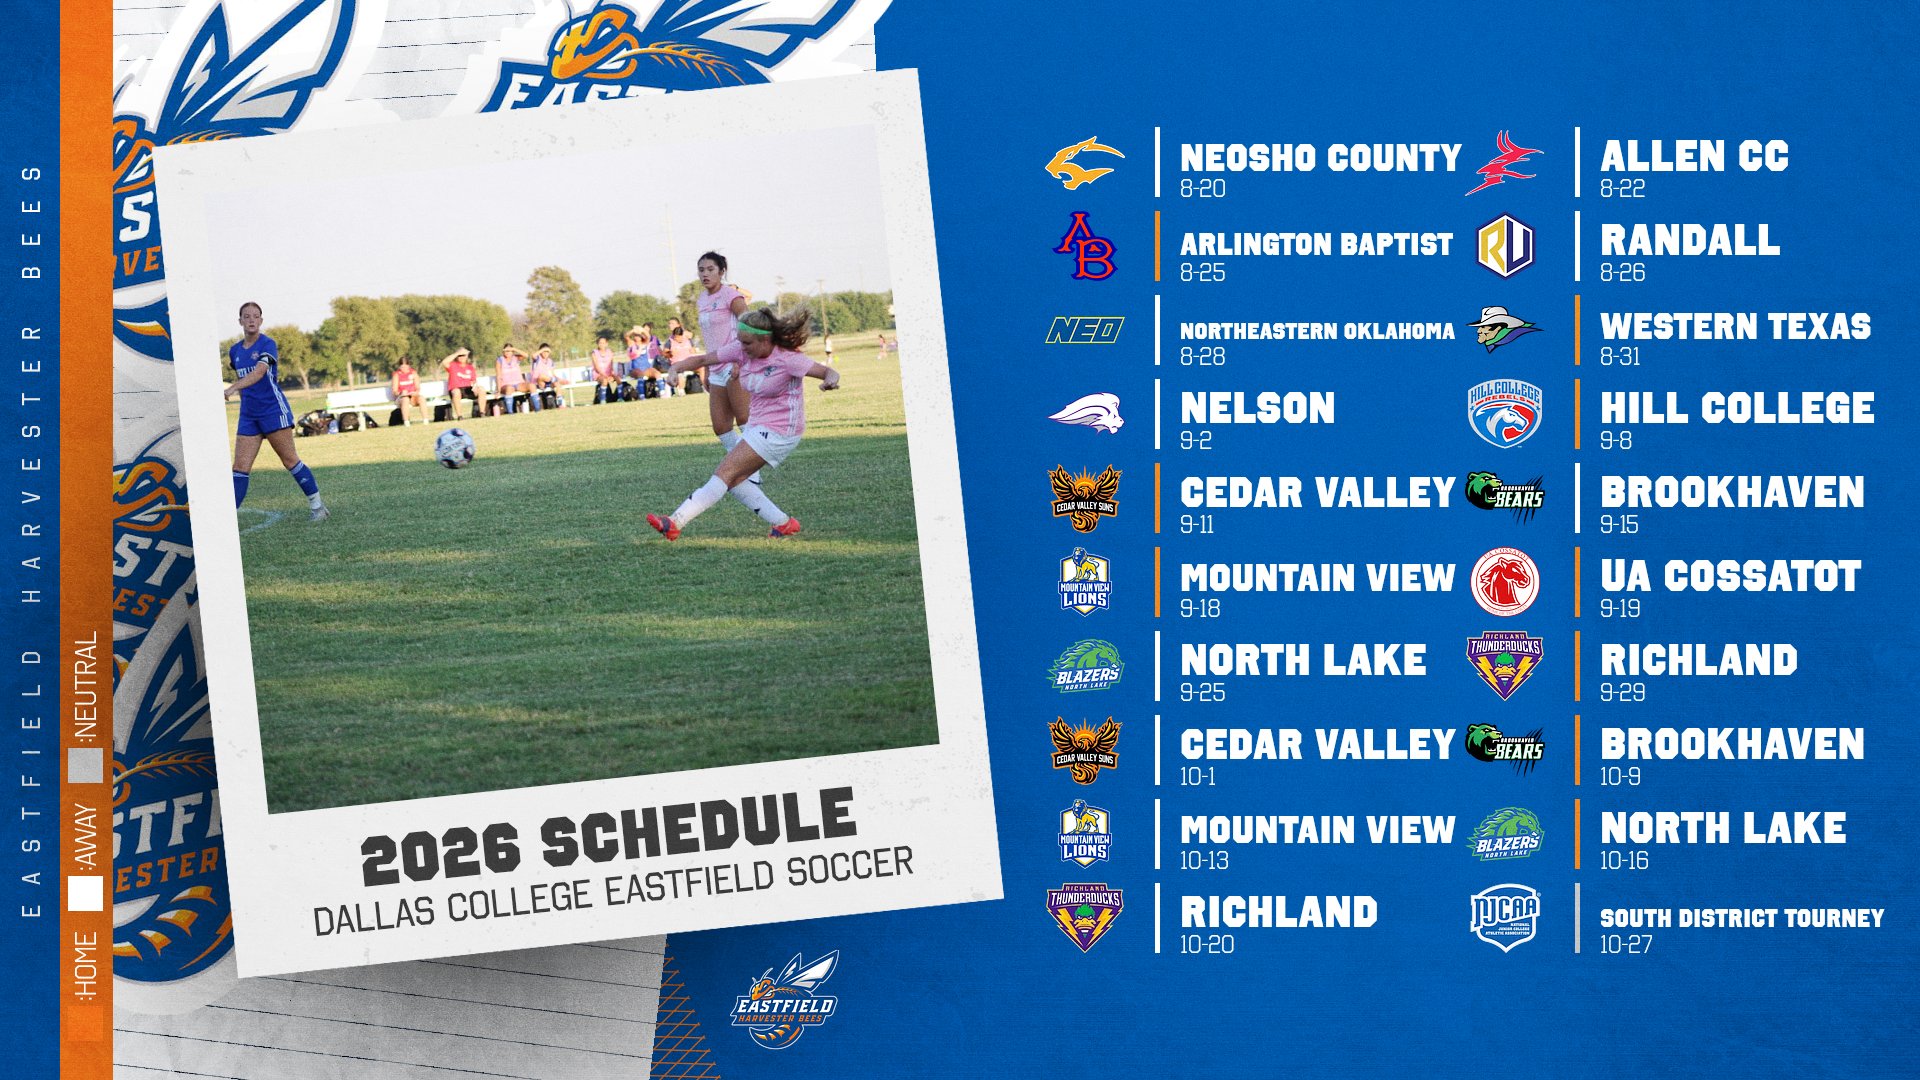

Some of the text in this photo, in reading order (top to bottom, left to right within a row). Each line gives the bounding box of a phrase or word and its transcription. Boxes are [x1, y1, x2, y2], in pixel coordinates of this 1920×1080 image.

[1182, 144, 1462, 171] NEOSHO COUNTY
[1601, 140, 1788, 171] ALLEN CC
[1181, 179, 1225, 197] 8-20
[1601, 179, 1644, 197] 8-22
[1181, 233, 1453, 255] ARLINGTON BAPTIST
[1602, 224, 1780, 255] RANDALL
[1181, 263, 1224, 281] 8-25
[1601, 263, 1644, 281] 8-26
[1045, 316, 1125, 344] NEO
[1181, 323, 1455, 339] NORTHEASTERN OKLAHOMA
[1601, 313, 1870, 339] WESTERN TEXAS
[1181, 347, 1224, 365] 8-28
[1601, 347, 1639, 365] 8-31
[1470, 381, 1540, 404] HILL COLLEGE
[1484, 394, 1526, 402] REBELS
[1182, 392, 1334, 423] NELSON
[1602, 392, 1874, 423] HILL COLLEGE
[1181, 431, 1211, 449] 9-2
[1601, 431, 1631, 449] 9-8
[1182, 477, 1456, 507] CEDAR VALLEY
[1494, 491, 1544, 508] BEARS
[1602, 476, 1863, 507] BROOKHAVEN
[1056, 501, 1114, 512] CEDAR VALLEY SUNS
[1181, 515, 1213, 533] 9-11
[1601, 515, 1638, 533] 9-15
[21, 167, 41, 917] EASTFIELD HARVESTER BEES
[1182, 564, 1456, 591] MOUNTAIN VIEW
[1602, 559, 1861, 591] UA COSSATOT
[1060, 583, 1110, 592] MOUNTAIN VIEW
[1063, 592, 1107, 607] LIONS
[1181, 599, 1219, 617] 9-18
[1601, 599, 1640, 617] 9-19
[1471, 640, 1540, 655] THUNDERDUCKS
[1182, 644, 1426, 675] NORTH LAKE
[1602, 644, 1797, 675] RICHLAND
[1056, 668, 1120, 685] BLAZERS
[1181, 683, 1225, 701] 9-25
[1601, 683, 1644, 701] 9-29
[1182, 729, 1456, 759] CEDAR VALLEY
[1494, 743, 1544, 760] BEARS
[1602, 728, 1863, 759] BROOKHAVEN
[1056, 753, 1114, 764] CEDAR VALLEY SUNS
[1182, 767, 1215, 785] 10-1
[1602, 767, 1640, 785] 10-9
[1182, 816, 1455, 843] MOUNTAIN VIEW
[1602, 812, 1846, 843] NORTH LAKE
[361, 787, 857, 887] 2026 SCHEDULE
[1060, 835, 1110, 844] MOUNTAIN VIEW
[1476, 836, 1540, 853] BLAZERS
[1063, 844, 1107, 859] LIONS
[1182, 851, 1228, 869] 10-13
[1602, 851, 1648, 869] 10-16
[314, 846, 913, 937] DALLAS COLLEGE EASTFIELD SOCCER
[1051, 892, 1120, 907] THUNDERDUCKS
[1182, 896, 1377, 927] RICHLAND
[1472, 896, 1539, 929] NJCAA
[1601, 909, 1884, 927] SOUTH DISTRICT TOURNEY
[1182, 935, 1234, 953] 10-20
[1602, 935, 1652, 953] 10-27
[737, 999, 834, 1013] EASTFIELD
[738, 1014, 823, 1023] HARVESTER BEES
